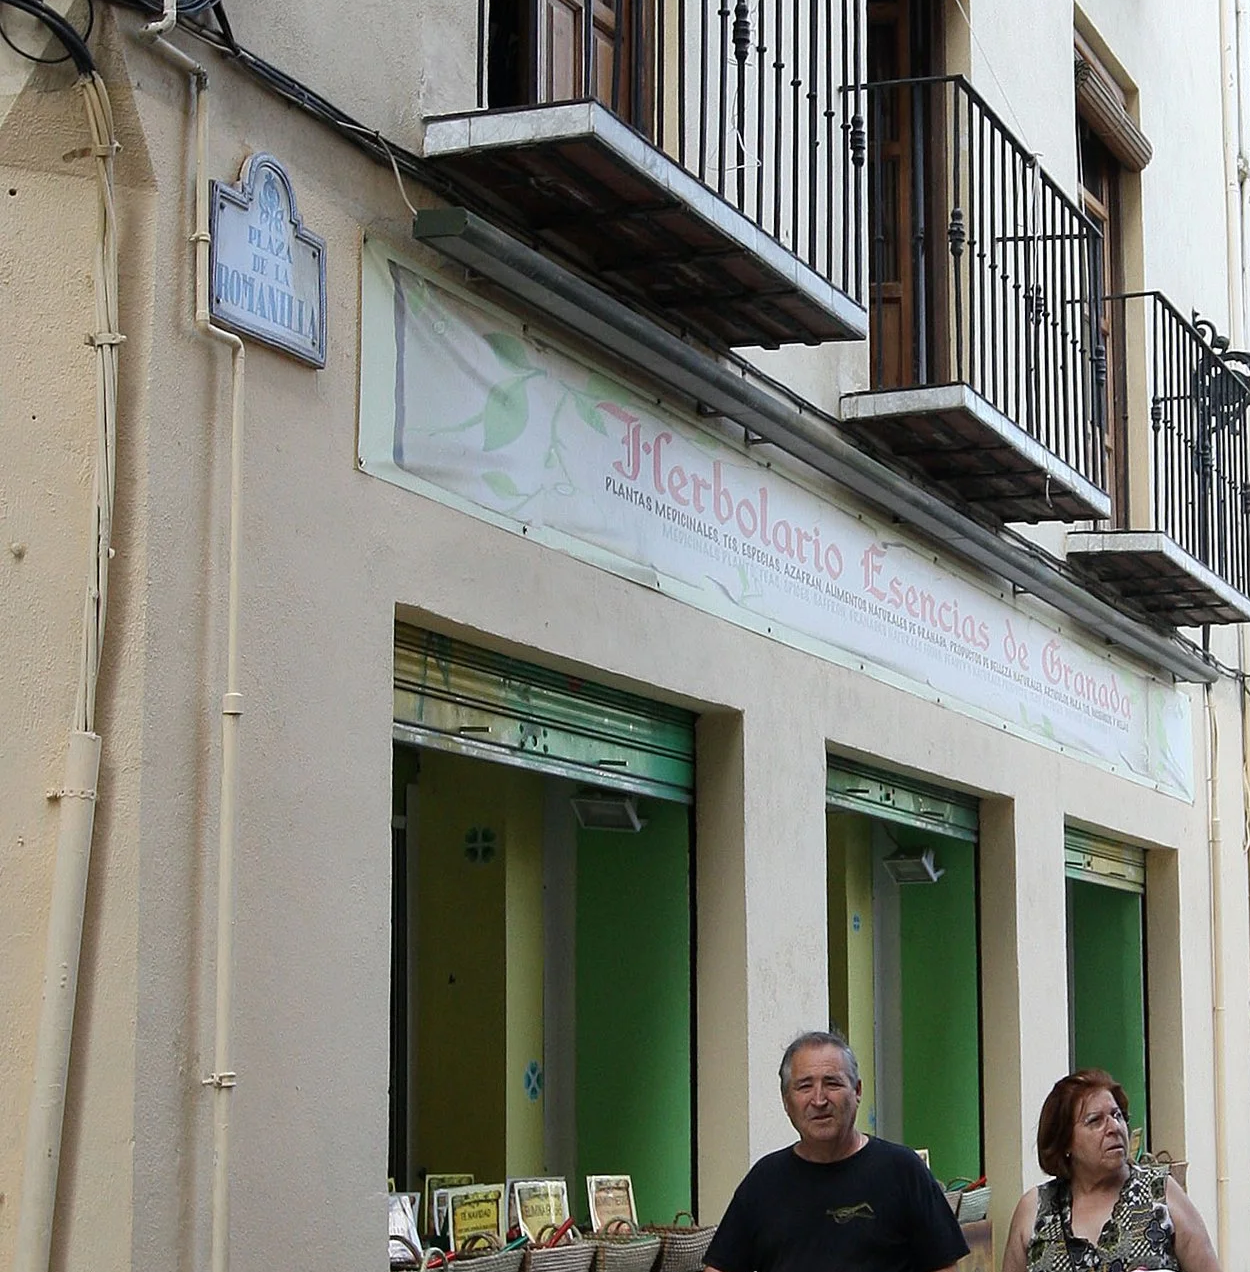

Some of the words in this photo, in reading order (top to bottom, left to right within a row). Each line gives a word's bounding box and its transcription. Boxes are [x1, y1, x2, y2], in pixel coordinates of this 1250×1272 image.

[248, 225, 293, 264] PLAZA
[251, 251, 268, 276] DE
[275, 262, 290, 287] LA
[216, 262, 318, 341] ROMANILLA
[605, 476, 652, 512] PLANTAS
[596, 401, 845, 580] Herbolario
[860, 542, 990, 652] Esencias
[1003, 618, 1030, 672] de
[1041, 638, 1132, 720] Granada
